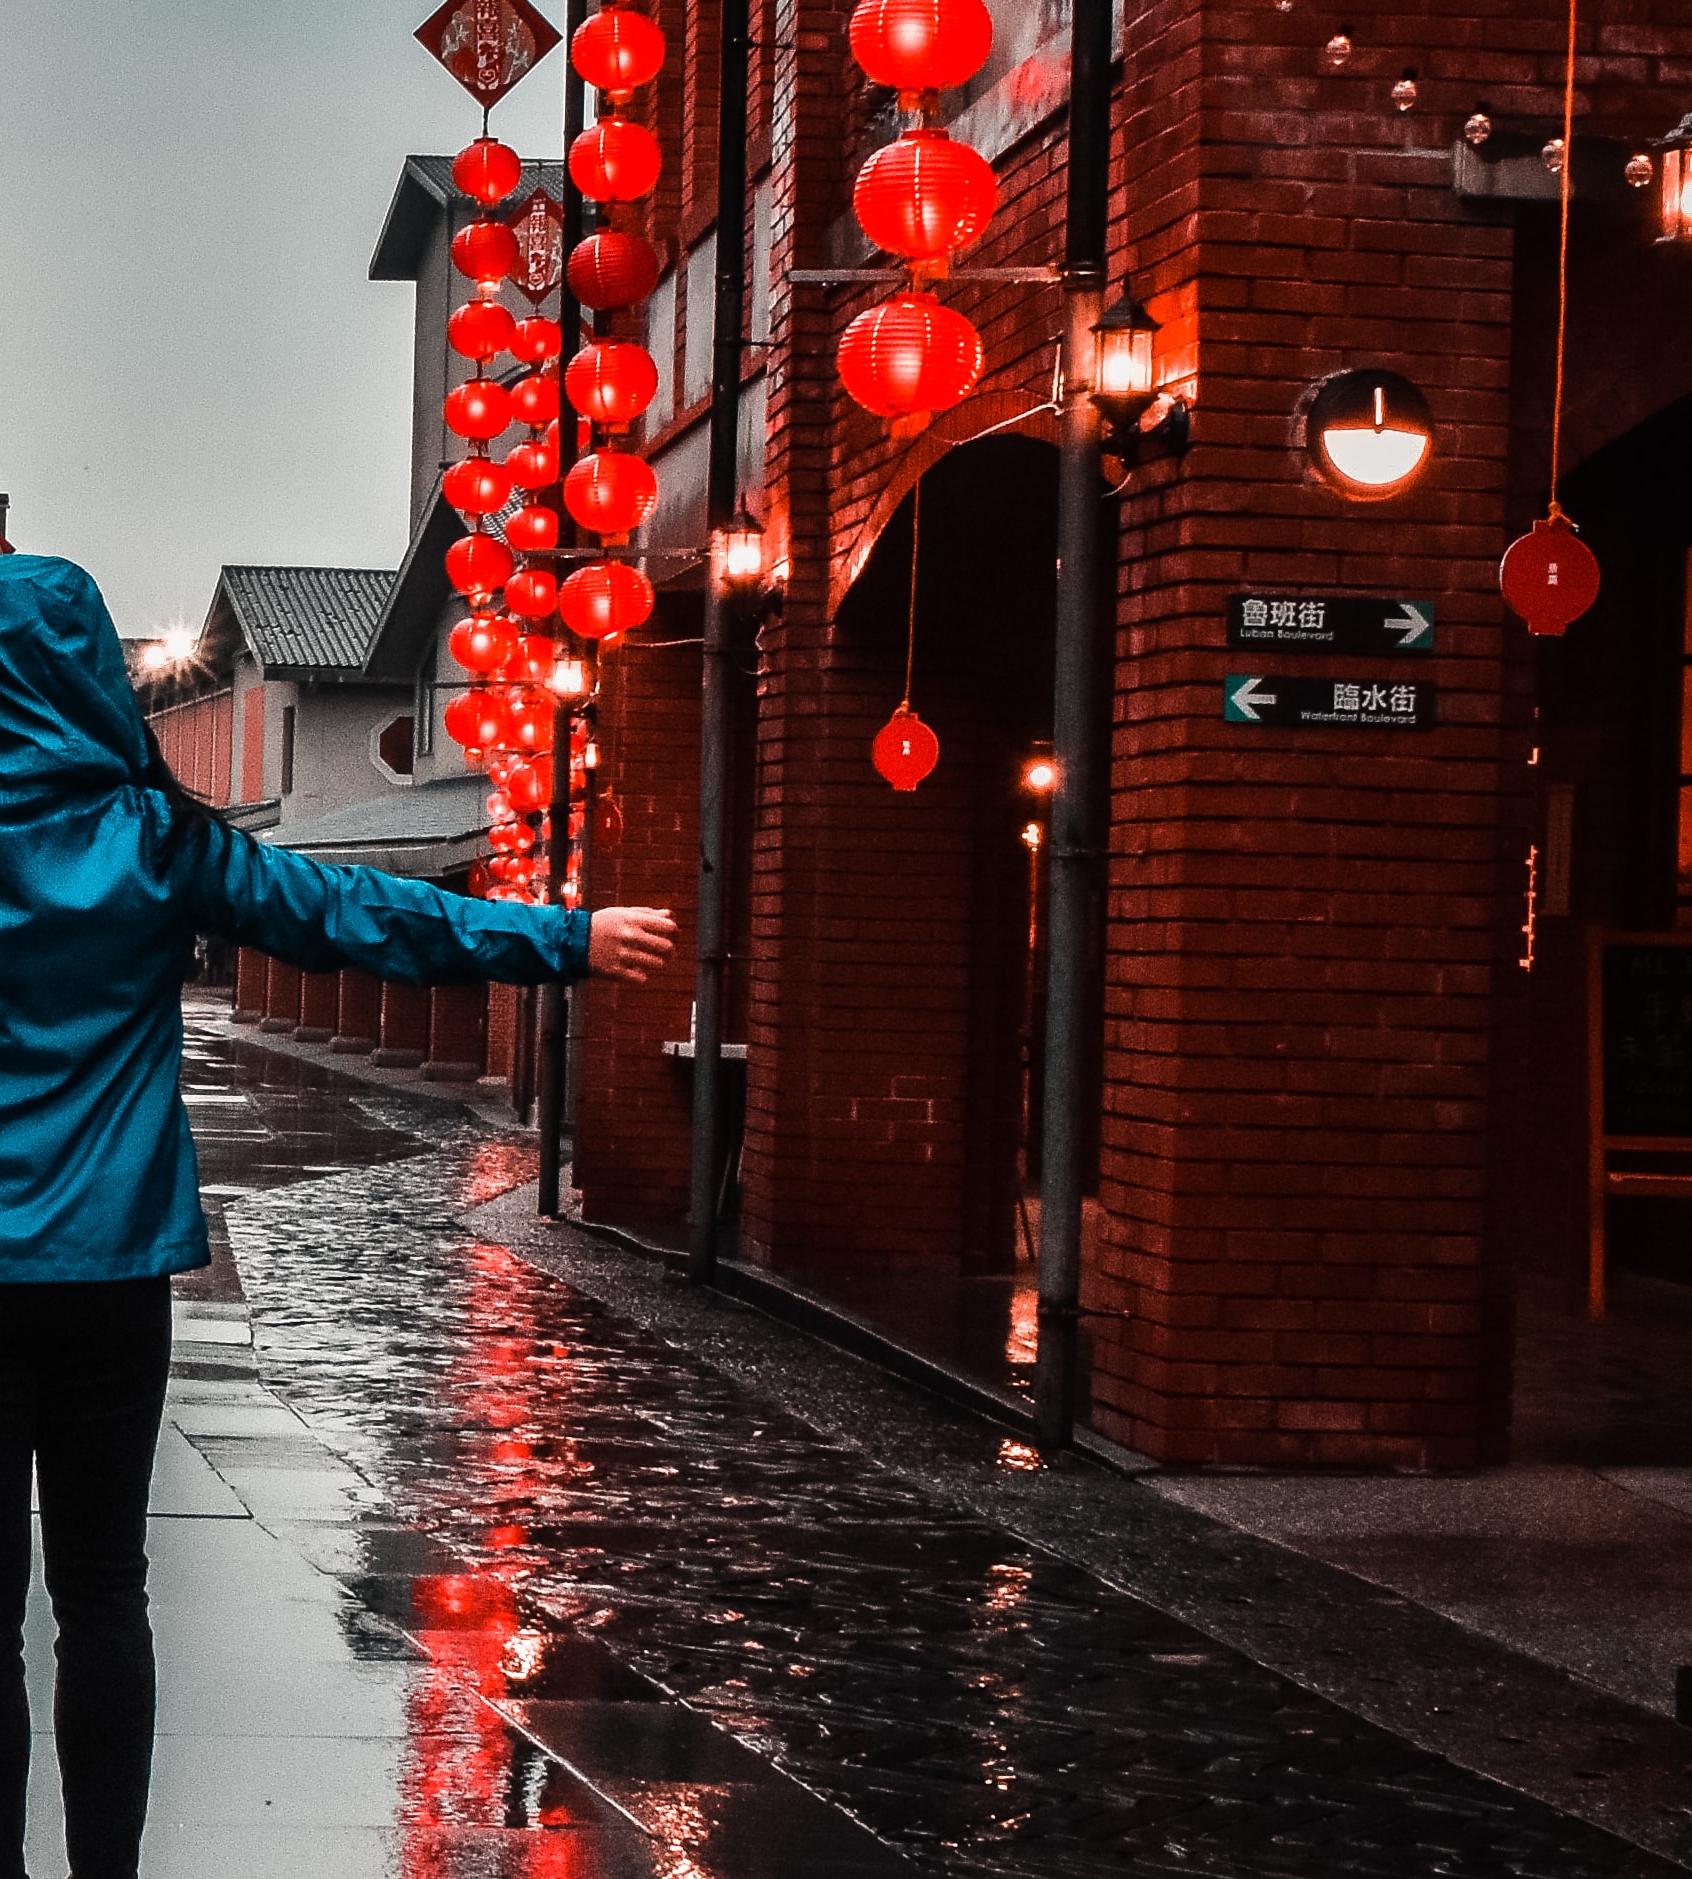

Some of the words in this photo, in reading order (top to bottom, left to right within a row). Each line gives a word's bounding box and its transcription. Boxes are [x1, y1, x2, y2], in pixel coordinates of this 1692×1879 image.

[1242, 599, 1325, 628] 魯班街
[1334, 683, 1416, 712] 臨水街
